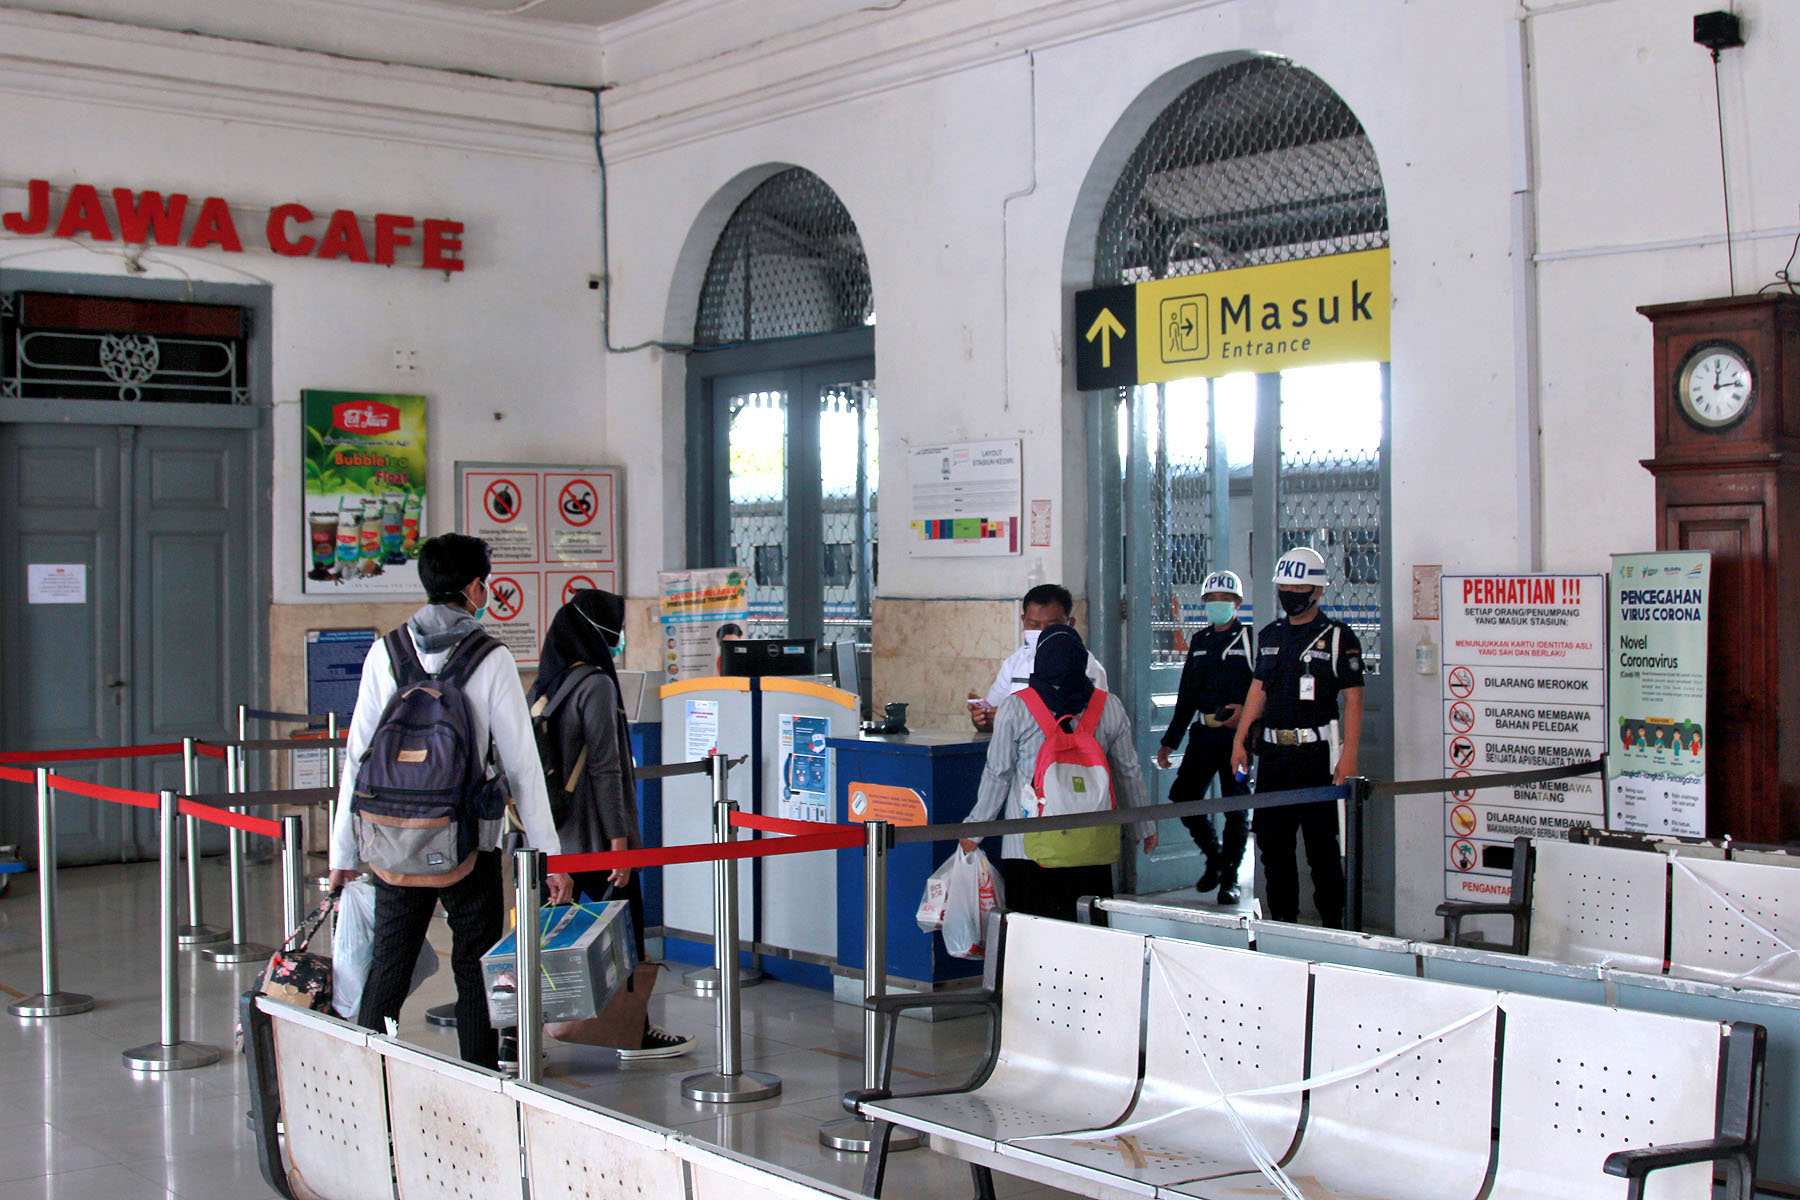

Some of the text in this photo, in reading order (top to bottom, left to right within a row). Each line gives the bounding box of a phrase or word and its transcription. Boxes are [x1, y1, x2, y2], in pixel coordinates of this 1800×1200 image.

[2, 179, 465, 272] JAWA CAFE
[1220, 279, 1373, 335] Masuk
[1222, 337, 1311, 359] Entrance
[1277, 560, 1307, 579] PKD
[1209, 576, 1235, 590] PKD
[1463, 578, 1581, 605] PERHATIAN !!!
[1620, 589, 1702, 605] PENCEGAHAN
[1464, 608, 1580, 617] SETIAP ORANG/PENUMPANG
[1621, 608, 1702, 621] VIRUS CORONA
[1475, 617, 1569, 626] YANG MASUK STASIUN:
[1456, 640, 1509, 648] MENUNJUKKAN
[1537, 641, 1574, 649] IDENTITAS
[1575, 642, 1592, 650] ASLI
[1620, 634, 1647, 649] Novel
[1515, 649, 1530, 657] DAN
[1620, 653, 1678, 669] Coronavirus
[1484, 677, 1588, 690] DILARANG MEROKOK
[1485, 708, 1591, 721] DILARANG MEMBAWA
[1495, 719, 1579, 732] BAHAN PELEDAK
[1485, 743, 1592, 758] DILARANG MEMBAWA
[1538, 781, 1592, 793] MEMBAWA
[1514, 790, 1565, 803] BINATANG
[1486, 812, 1592, 829] DILARANG MEMBAWA
[1537, 828, 1559, 839] BERBAU
[487, 963, 514, 972] EPSON
